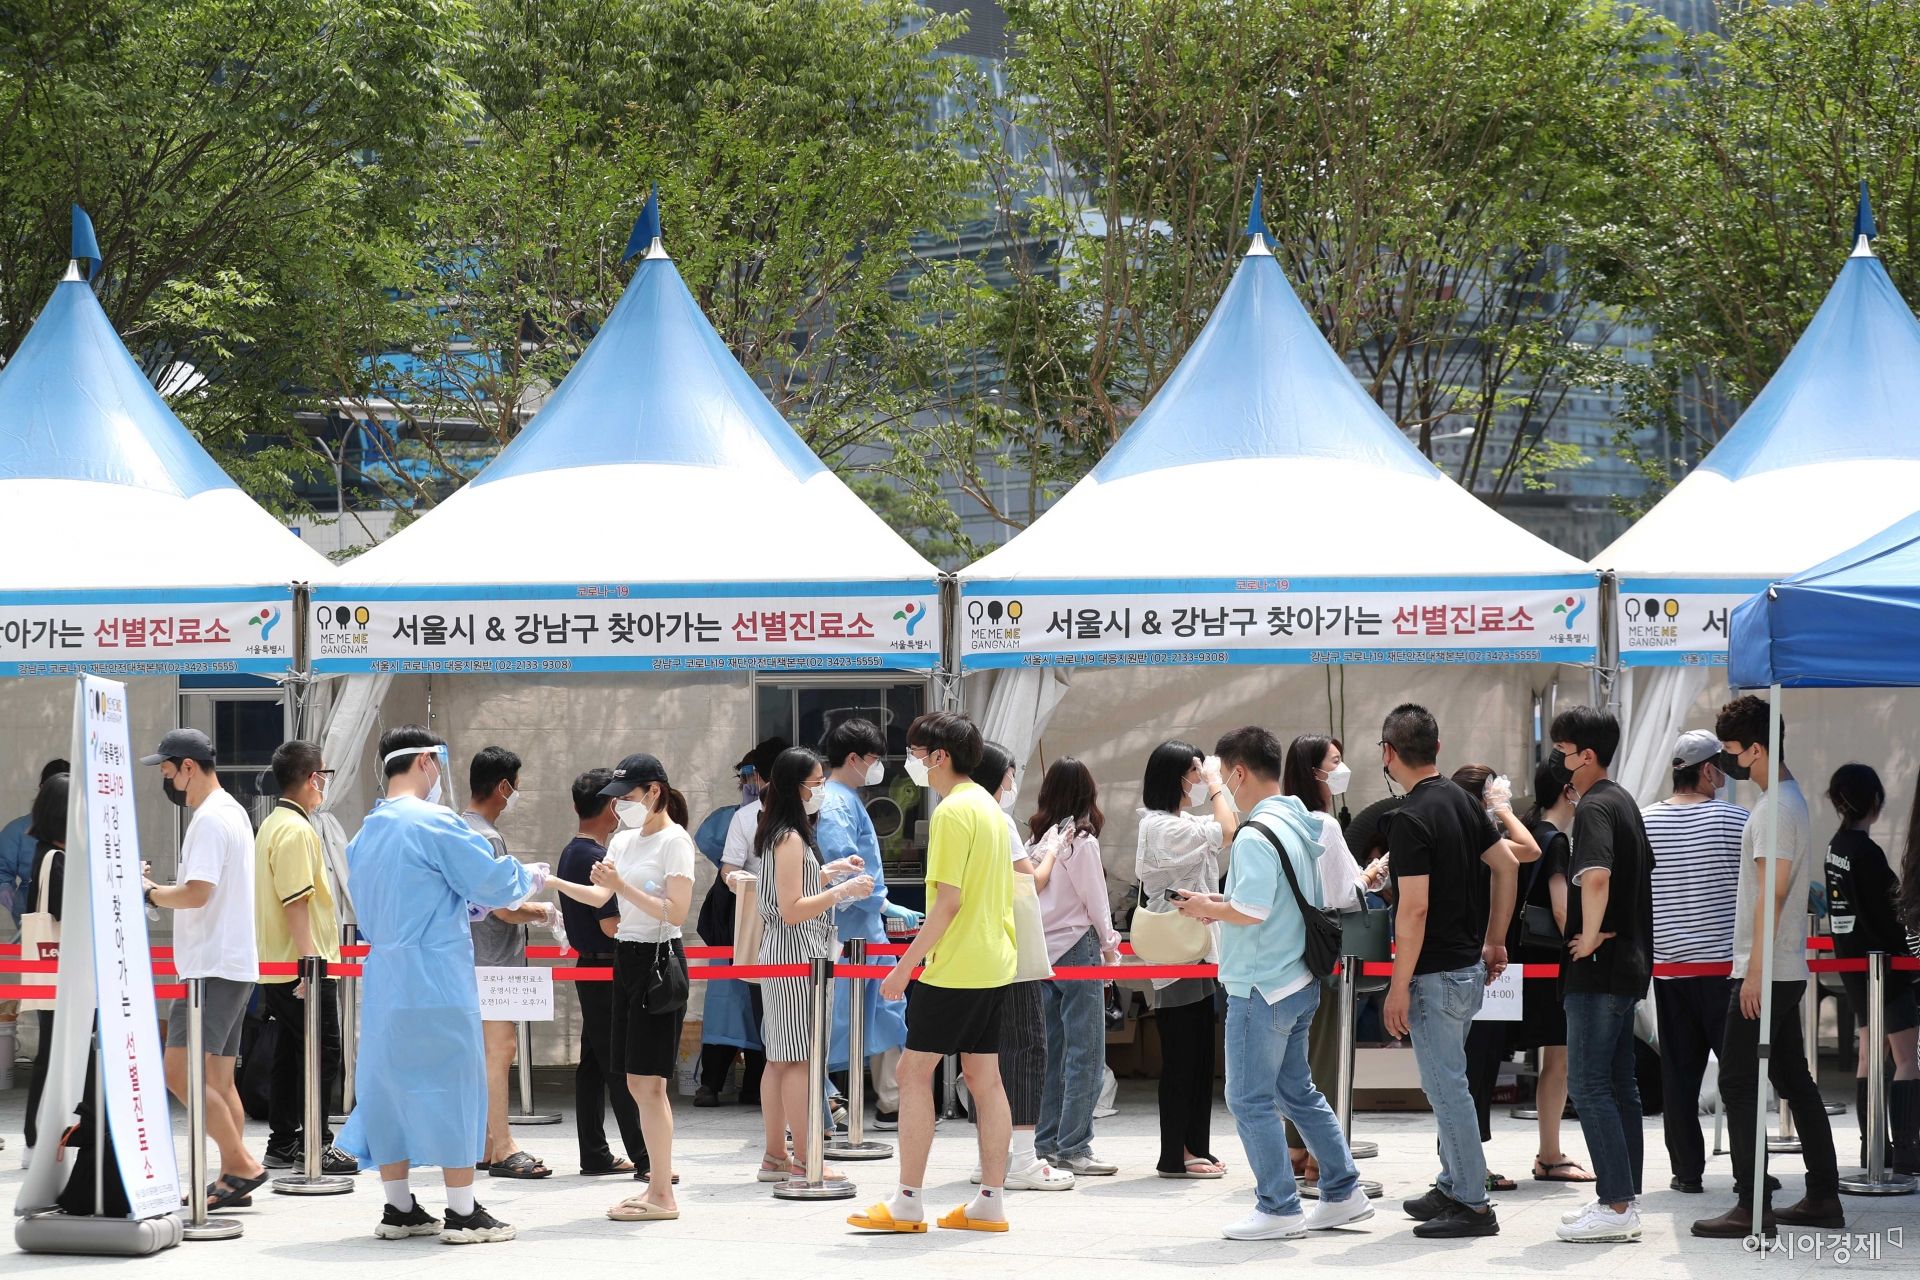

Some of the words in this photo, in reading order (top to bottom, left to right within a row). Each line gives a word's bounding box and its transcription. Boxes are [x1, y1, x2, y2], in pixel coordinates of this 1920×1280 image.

[576, 585, 630, 597] 코로나-19
[1236, 580, 1290, 591] 코로나-19
[1046, 607, 1130, 639] 서울시
[1141, 610, 1162, 635] &
[1171, 606, 1257, 637] 강남구
[1267, 605, 1382, 636] 찾아가는
[1391, 604, 1535, 635] 선별진료소
[0, 618, 84, 649] 아가는
[93, 617, 231, 648] 선별진료소
[392, 614, 475, 646] 서울시
[485, 616, 506, 642] &
[514, 613, 599, 645] 강남구
[608, 611, 722, 643] 찾아가는
[731, 611, 875, 642] 선별진료소
[1549, 633, 1590, 644] 서울특별시
[1629, 638, 1677, 647] GANGNAM
[245, 644, 285, 655] 서울특별시
[320, 644, 368, 654] GANGNAM
[889, 640, 932, 650] 서울특별시
[971, 640, 1020, 650] GANGNAM
[1022, 654, 1052, 666] 서울시
[1055, 654, 1095, 665] 코로나19
[1311, 651, 1340, 663] 강남구
[1344, 651, 1384, 661] 코로나19
[18, 663, 47, 675] 강남구
[50, 664, 87, 674] 코로나19
[371, 660, 399, 672] 서울시
[402, 661, 441, 671] 코로나19
[652, 658, 681, 670] 강남구
[685, 658, 725, 668] 코로나19
[98, 773, 124, 799] 코로나19
[103, 803, 114, 889] 서울시
[112, 804, 124, 889] 강남구
[112, 894, 131, 1017] 찾아가는
[522, 986, 537, 995] 안내
[126, 1031, 154, 1179] 선별진료소
